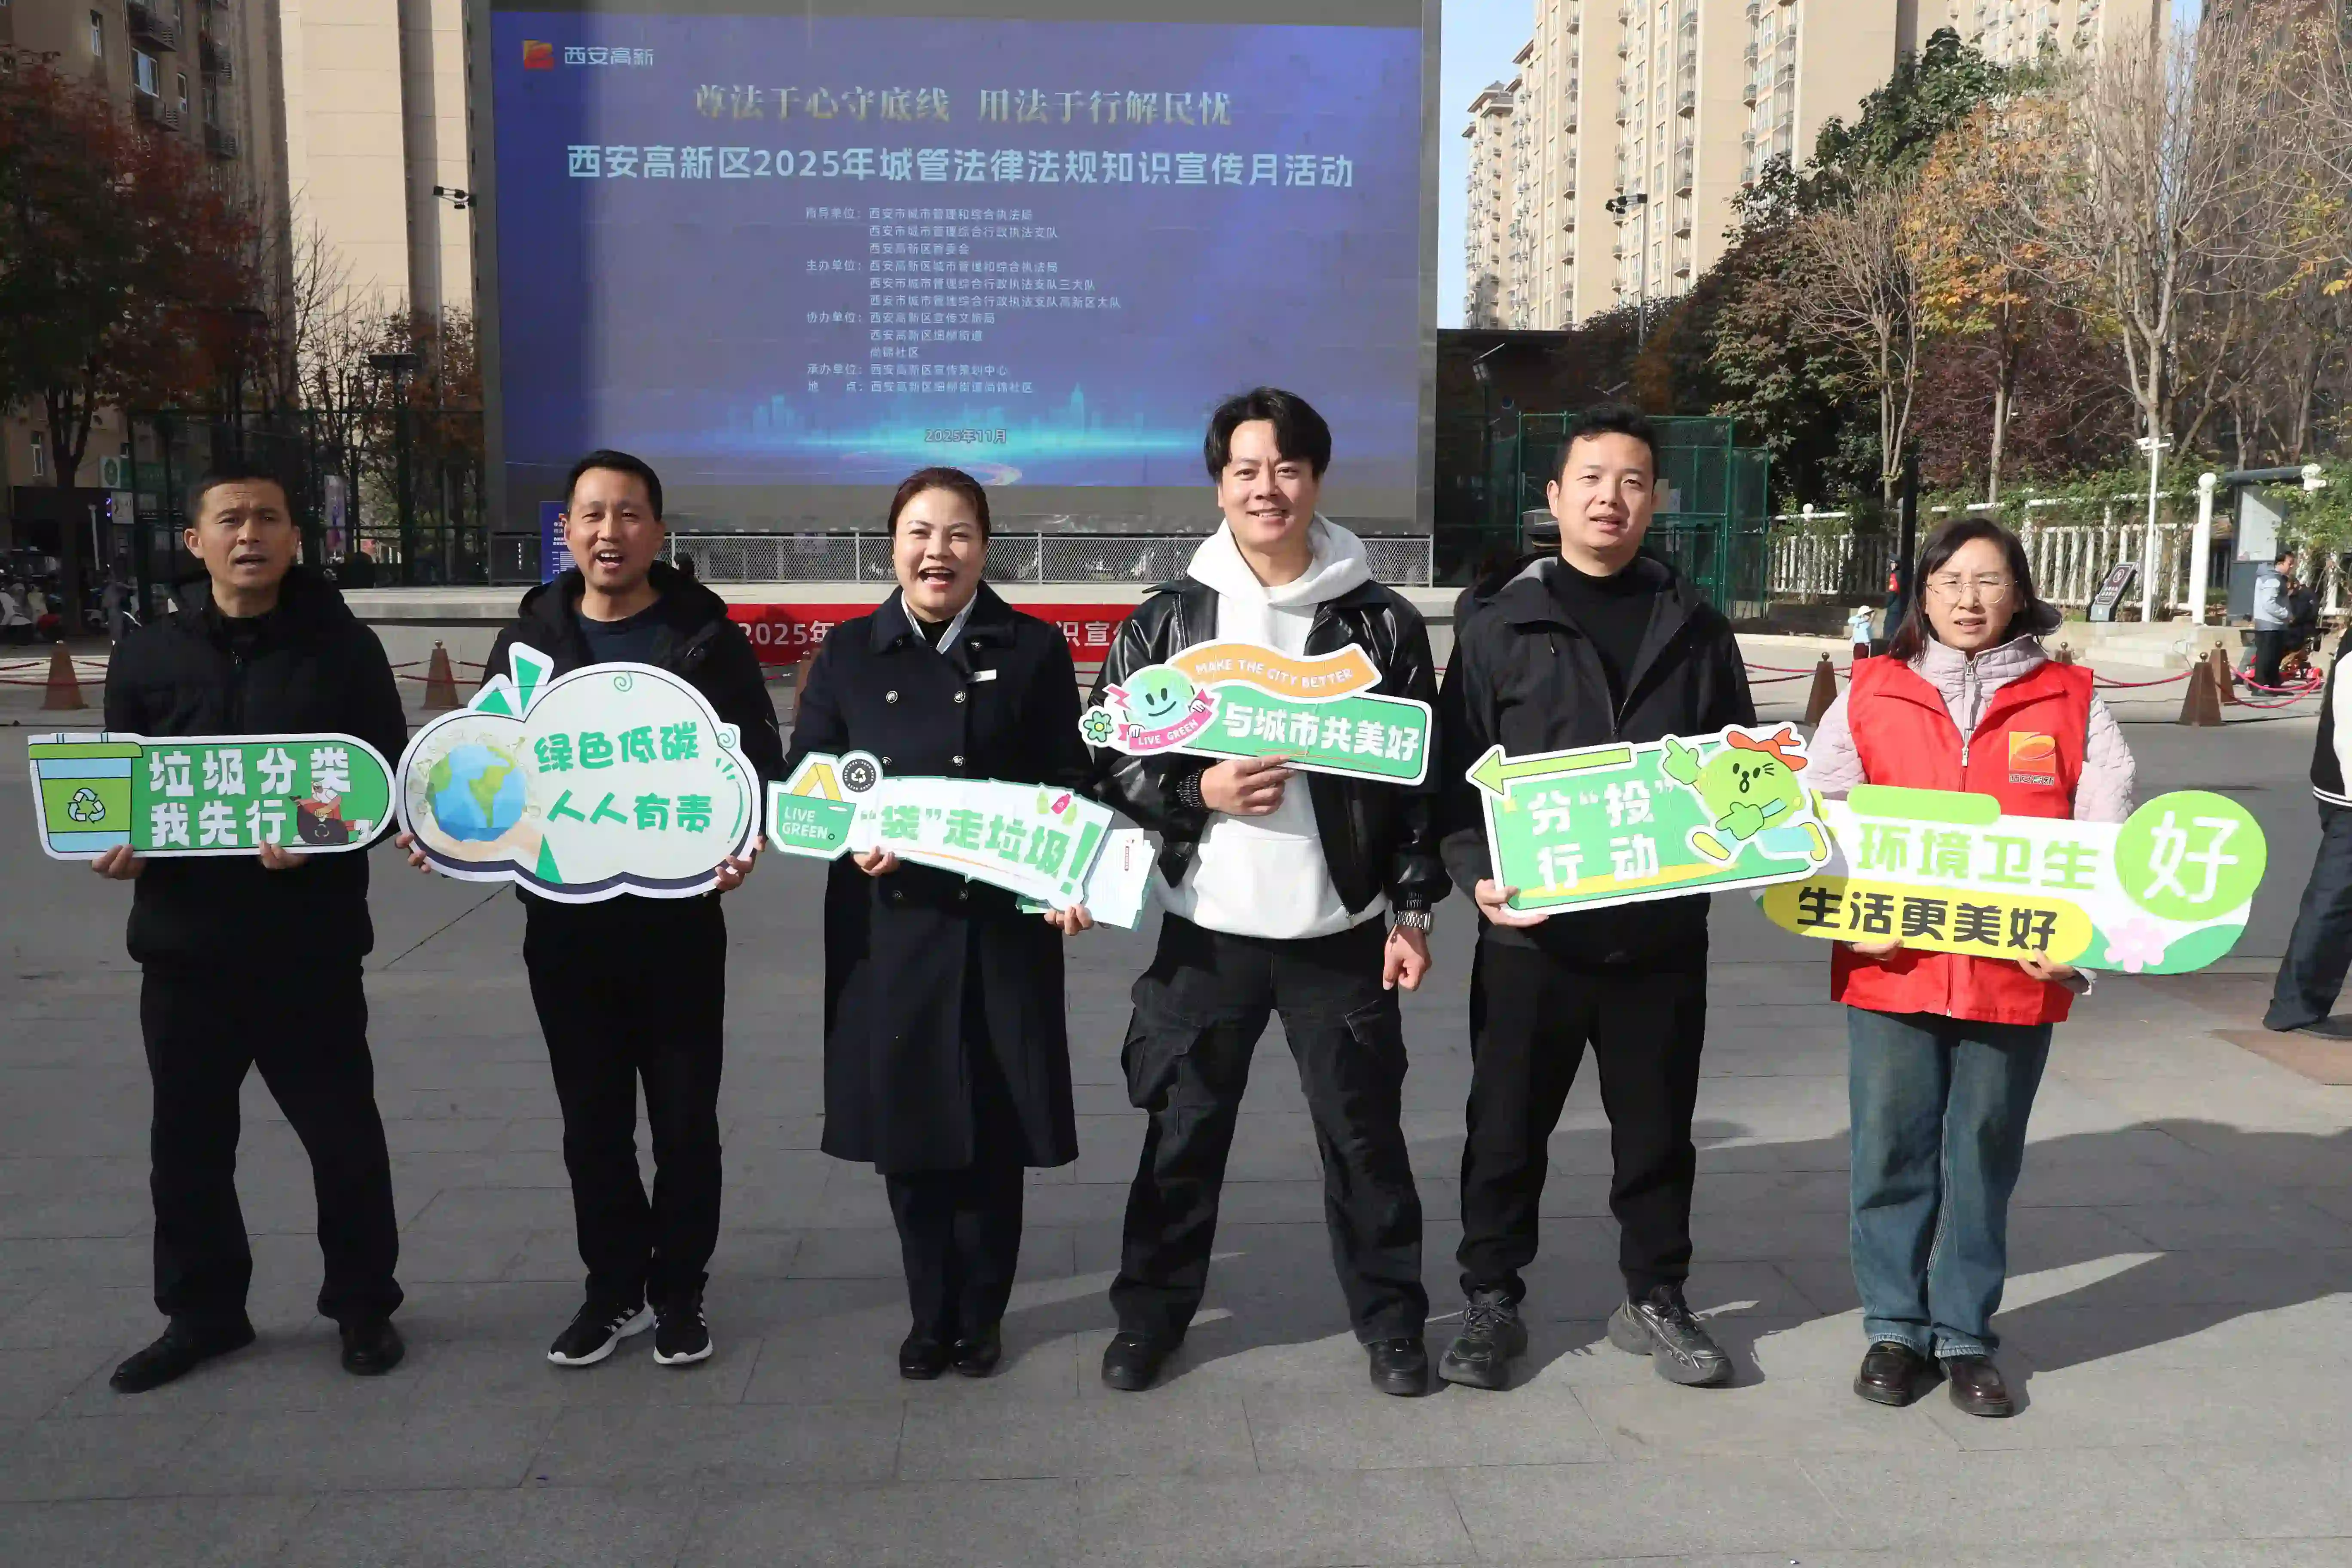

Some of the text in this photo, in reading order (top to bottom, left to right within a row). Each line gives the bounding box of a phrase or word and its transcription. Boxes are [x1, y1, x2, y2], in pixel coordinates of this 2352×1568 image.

[564, 46, 654, 66] 西安高新
[696, 85, 1231, 126] 尊法于心守底线 用法于行解民忧
[567, 145, 1353, 187] 西安高新区2025年城管法律法规知识宣传月活动
[925, 428, 1007, 444] 2025年11月
[1056, 621, 1124, 647] 识宣
[1194, 658, 1353, 689] MAKE THE CITY BETTER
[533, 721, 700, 774] 绿色低碳
[1138, 718, 1199, 746] LIVE GREEN
[1222, 702, 1420, 762] 与城市共美好
[149, 747, 351, 797] 垃圾分类
[2008, 773, 2055, 787] 西安高新
[150, 799, 287, 848] 我先行
[546, 789, 713, 833] 人人有责
[784, 806, 815, 823] LIVE
[1537, 833, 1660, 891] 行动
[1857, 823, 2103, 891] 环境卫生
[2143, 809, 2240, 904] 好
[1797, 886, 2057, 953] 生活更美好
